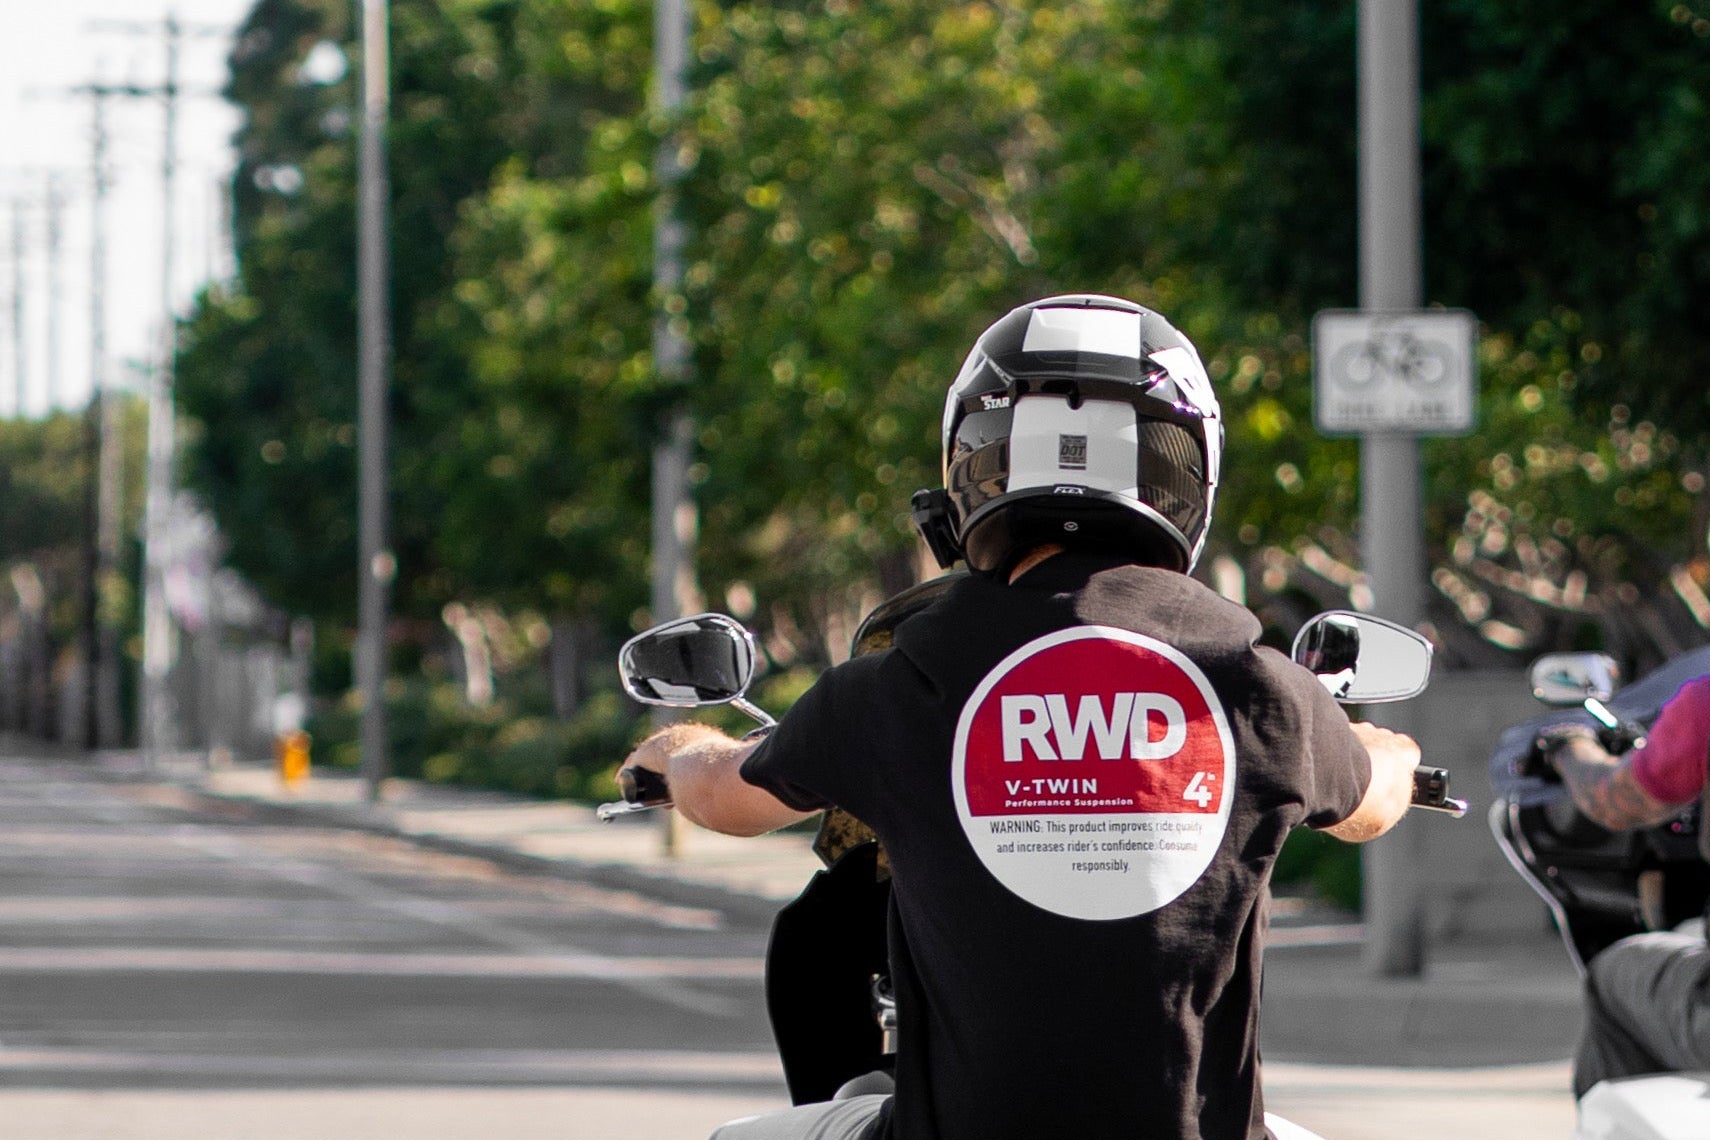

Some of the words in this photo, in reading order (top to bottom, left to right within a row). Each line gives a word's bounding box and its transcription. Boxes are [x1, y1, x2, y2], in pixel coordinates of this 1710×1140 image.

[983, 397, 1010, 410] STAR
[1001, 692, 1187, 762] RWD
[1004, 778, 1097, 796] V-TWIN
[1005, 799, 1071, 808] Performance
[1074, 798, 1134, 807] Suspension
[1046, 820, 1067, 832] This
[1069, 821, 1106, 835] product
[1108, 820, 1153, 834] improves
[1156, 820, 1174, 831] ride
[996, 841, 1015, 853] and
[1017, 841, 1065, 853] increases
[1160, 838, 1197, 851] Consume
